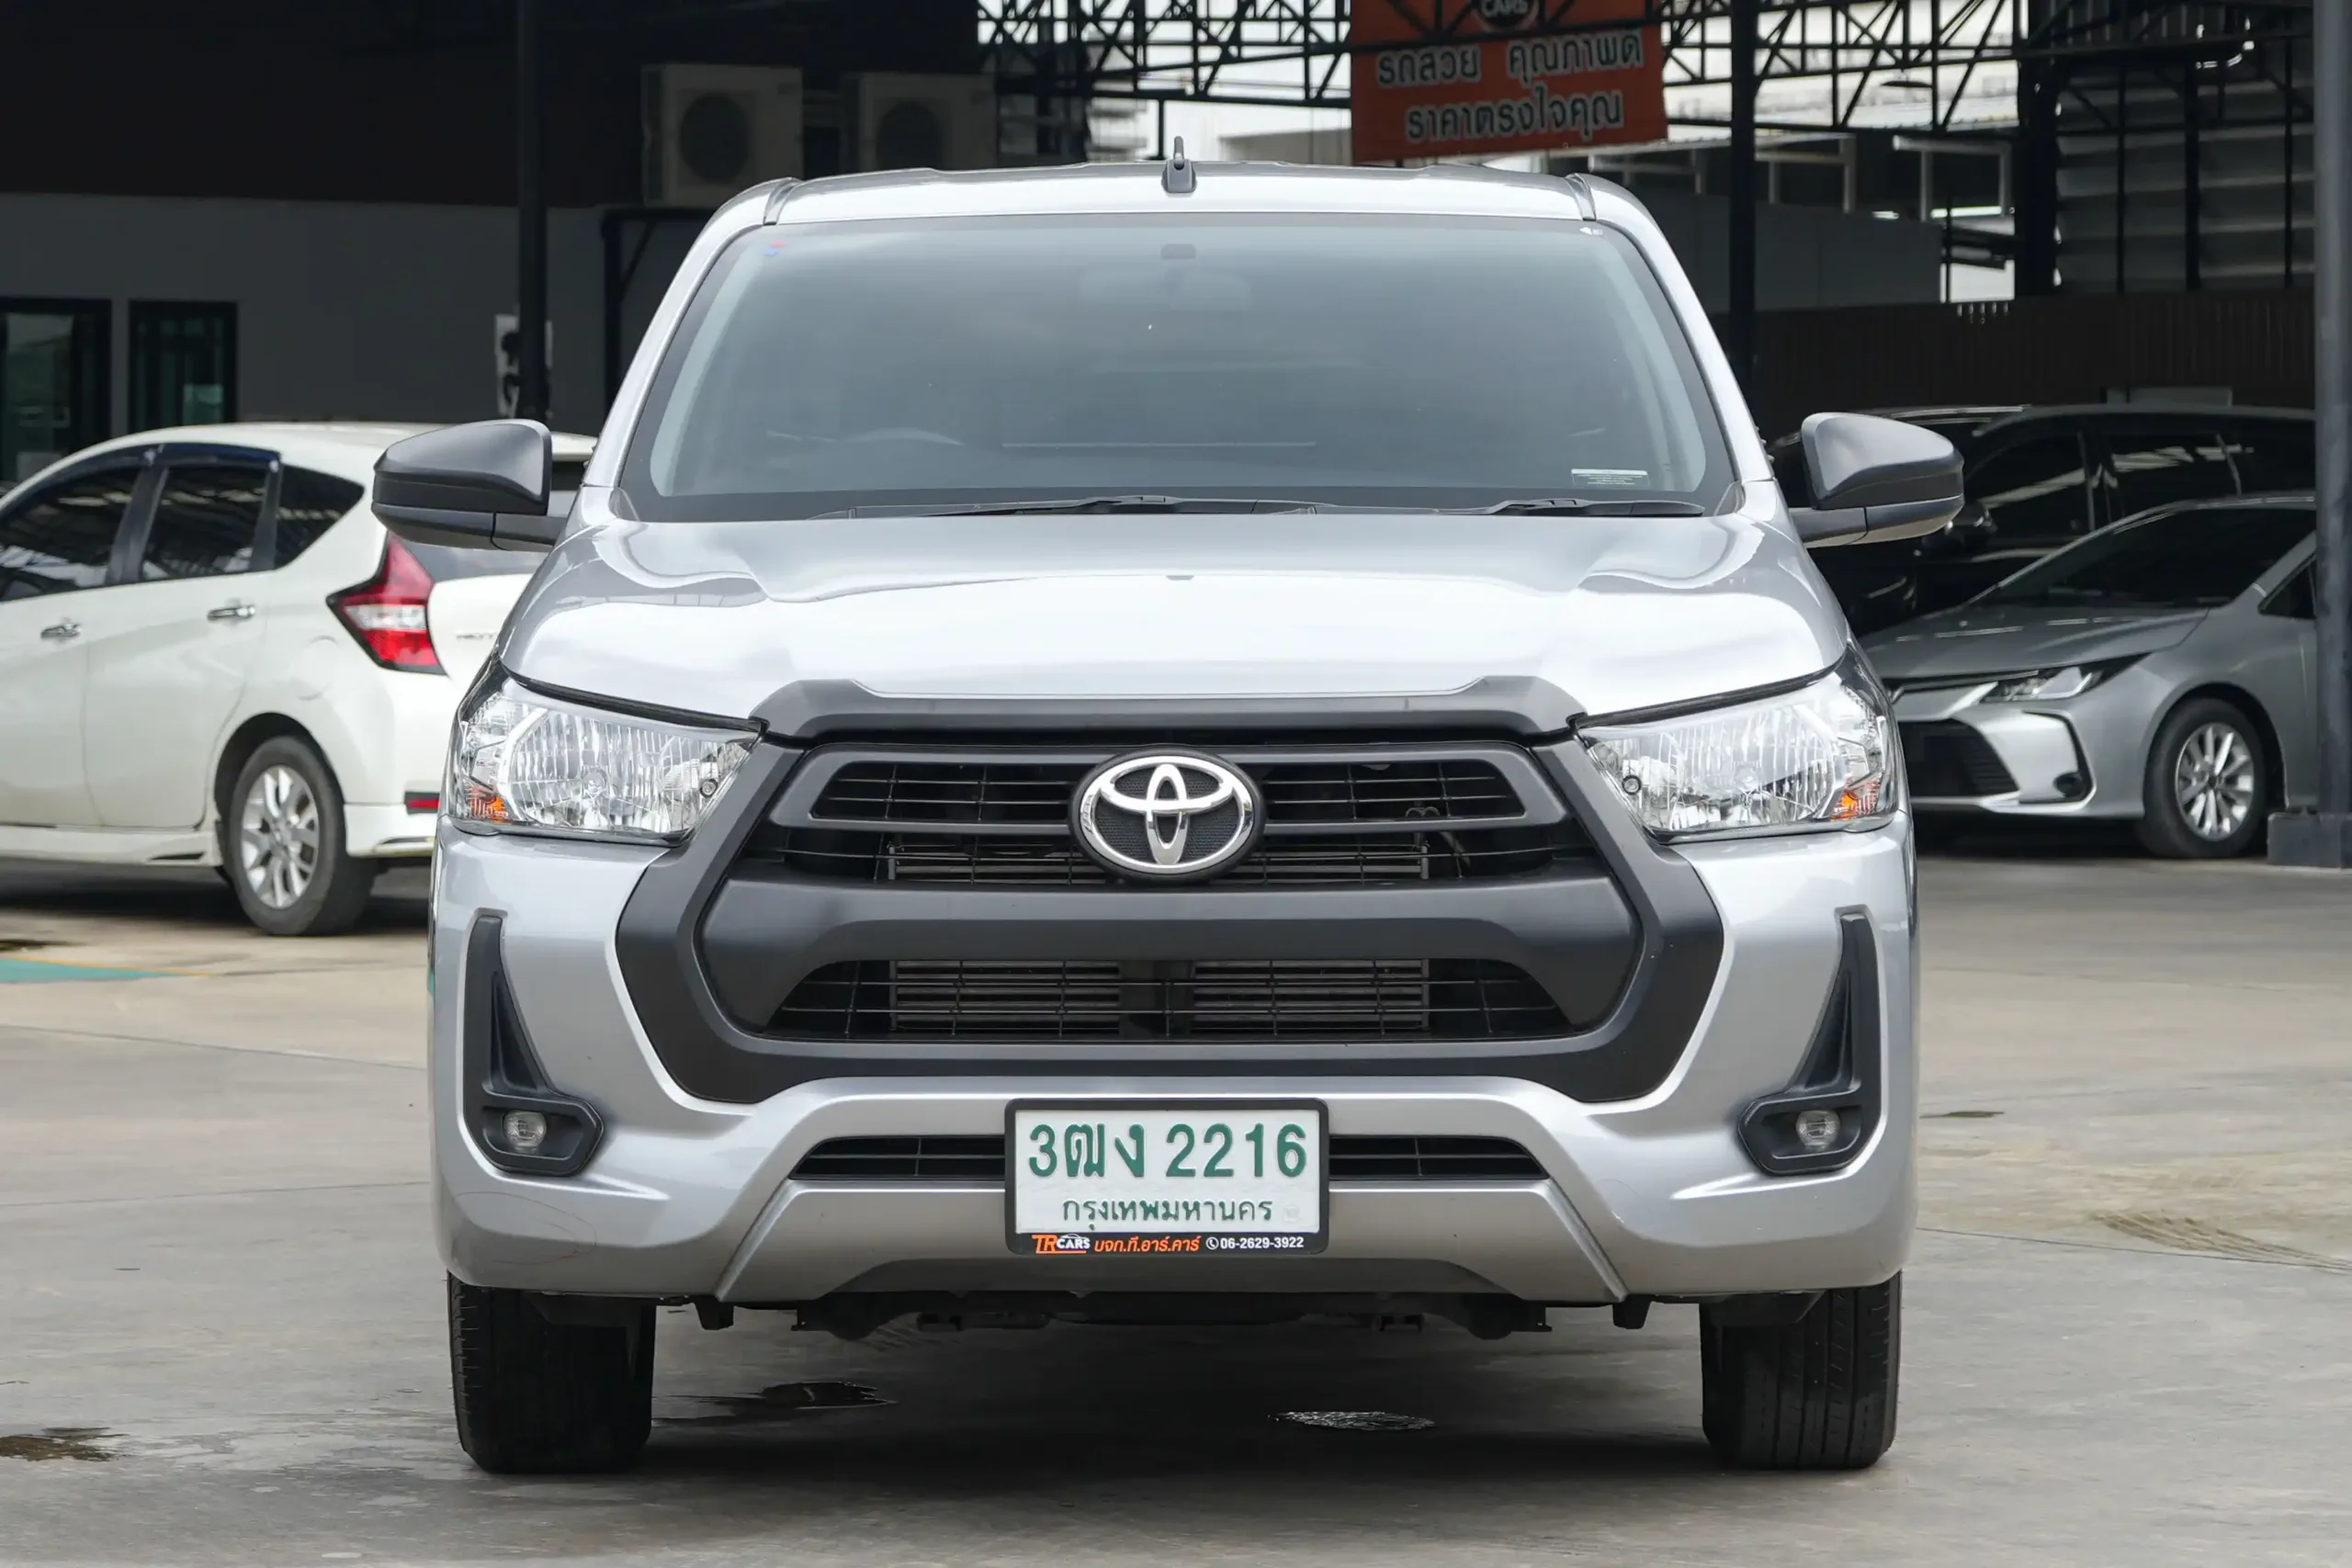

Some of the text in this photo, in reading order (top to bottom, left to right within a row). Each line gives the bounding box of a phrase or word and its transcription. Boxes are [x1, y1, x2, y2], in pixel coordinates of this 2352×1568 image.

[1508, 32, 1643, 85] คุณภาพด
[1166, 1122, 1306, 1178] 2216
[1062, 1200, 1273, 1231] กรุงเทพมหานคร
[1220, 1236, 1305, 1249] 06-2629-3922
